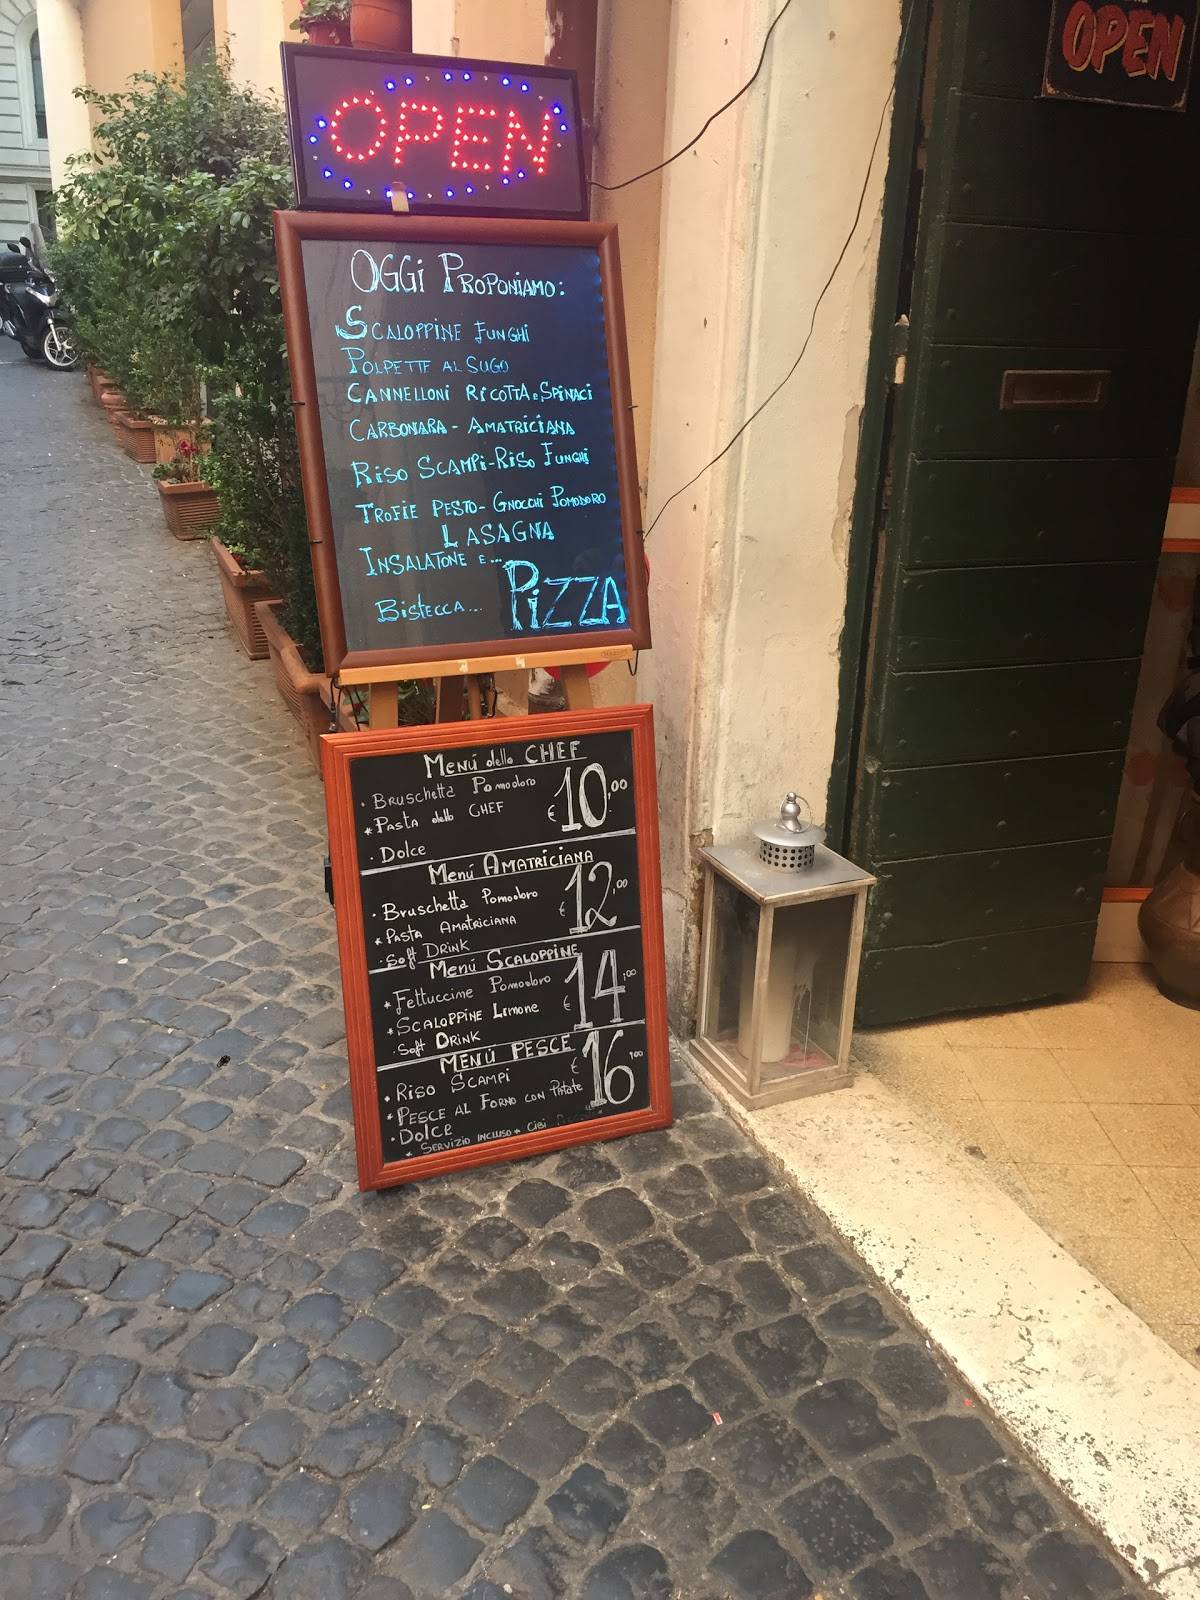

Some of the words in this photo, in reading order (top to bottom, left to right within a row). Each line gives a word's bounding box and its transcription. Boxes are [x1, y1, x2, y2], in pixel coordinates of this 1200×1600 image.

[1062, 0, 1186, 81] OPEN
[329, 96, 552, 176] OPEN
[442, 360, 463, 374] AL
[466, 355, 509, 374] SUGO
[349, 416, 448, 442] CARBONARA
[550, 484, 608, 508] POMODORO
[440, 520, 556, 550] LASAGNA
[358, 546, 468, 578] INSALATONE
[525, 740, 581, 764] CHEF
[471, 775, 537, 796] Pomodoro
[468, 801, 505, 818] CHEF
[379, 839, 427, 864] Dolce
[481, 888, 539, 905] Pomodoro
[511, 1034, 573, 1061] PESCE
[397, 1107, 447, 1127] PESCE
[454, 1102, 472, 1116] AL
[480, 1092, 517, 1111] FORNO
